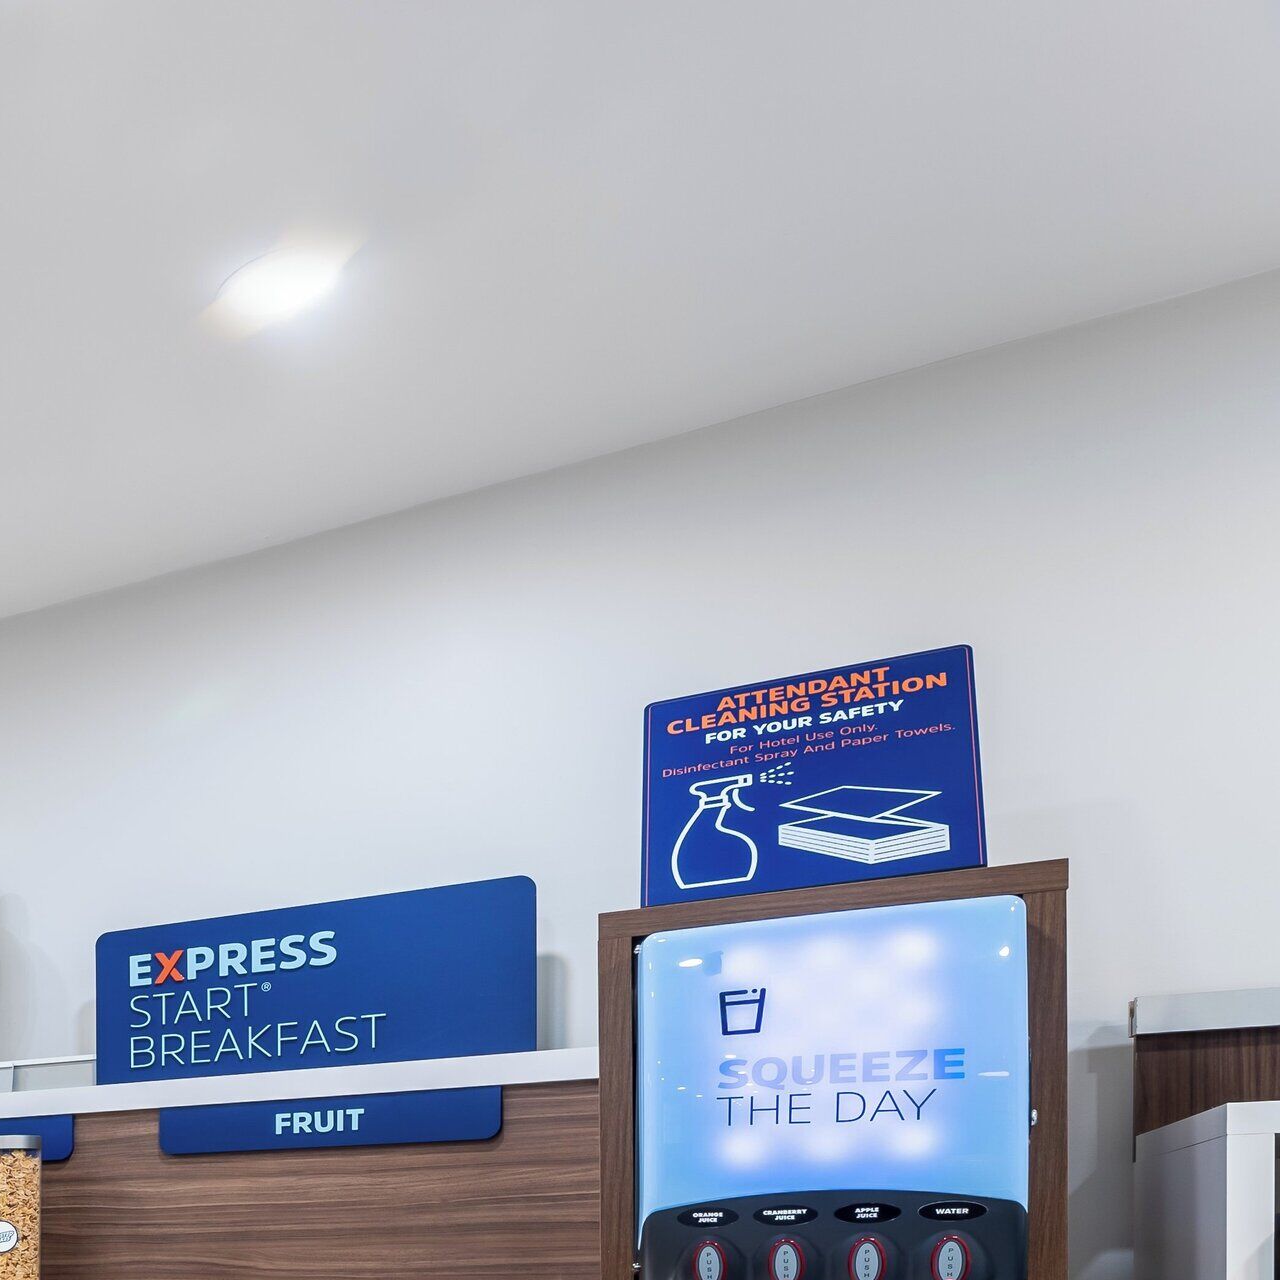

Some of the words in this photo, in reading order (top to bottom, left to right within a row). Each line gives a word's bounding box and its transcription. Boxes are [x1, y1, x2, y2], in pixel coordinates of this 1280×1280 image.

[666, 697, 811, 735] CLEANING
[821, 672, 947, 708] STATION
[717, 666, 890, 711] ATTENDANT
[705, 727, 746, 744] FOR
[753, 716, 813, 735] YOUR
[819, 699, 904, 724] SAFETY
[730, 744, 754, 754] For
[760, 735, 800, 749] Hotel
[805, 731, 834, 741] Use
[840, 724, 878, 736] Only.
[662, 757, 749, 778] Disinfectant
[755, 749, 798, 762] Spray
[804, 741, 835, 754] And
[841, 733, 889, 748] Paper
[895, 723, 955, 738] Towels.
[129, 930, 337, 987] EXPRESS
[130, 1013, 386, 1068] BREAKFAST
[718, 1048, 965, 1090] SQUEEZE
[275, 1108, 364, 1135] FRUIT
[717, 1093, 812, 1126] THE
[836, 1088, 937, 1123] DAY
